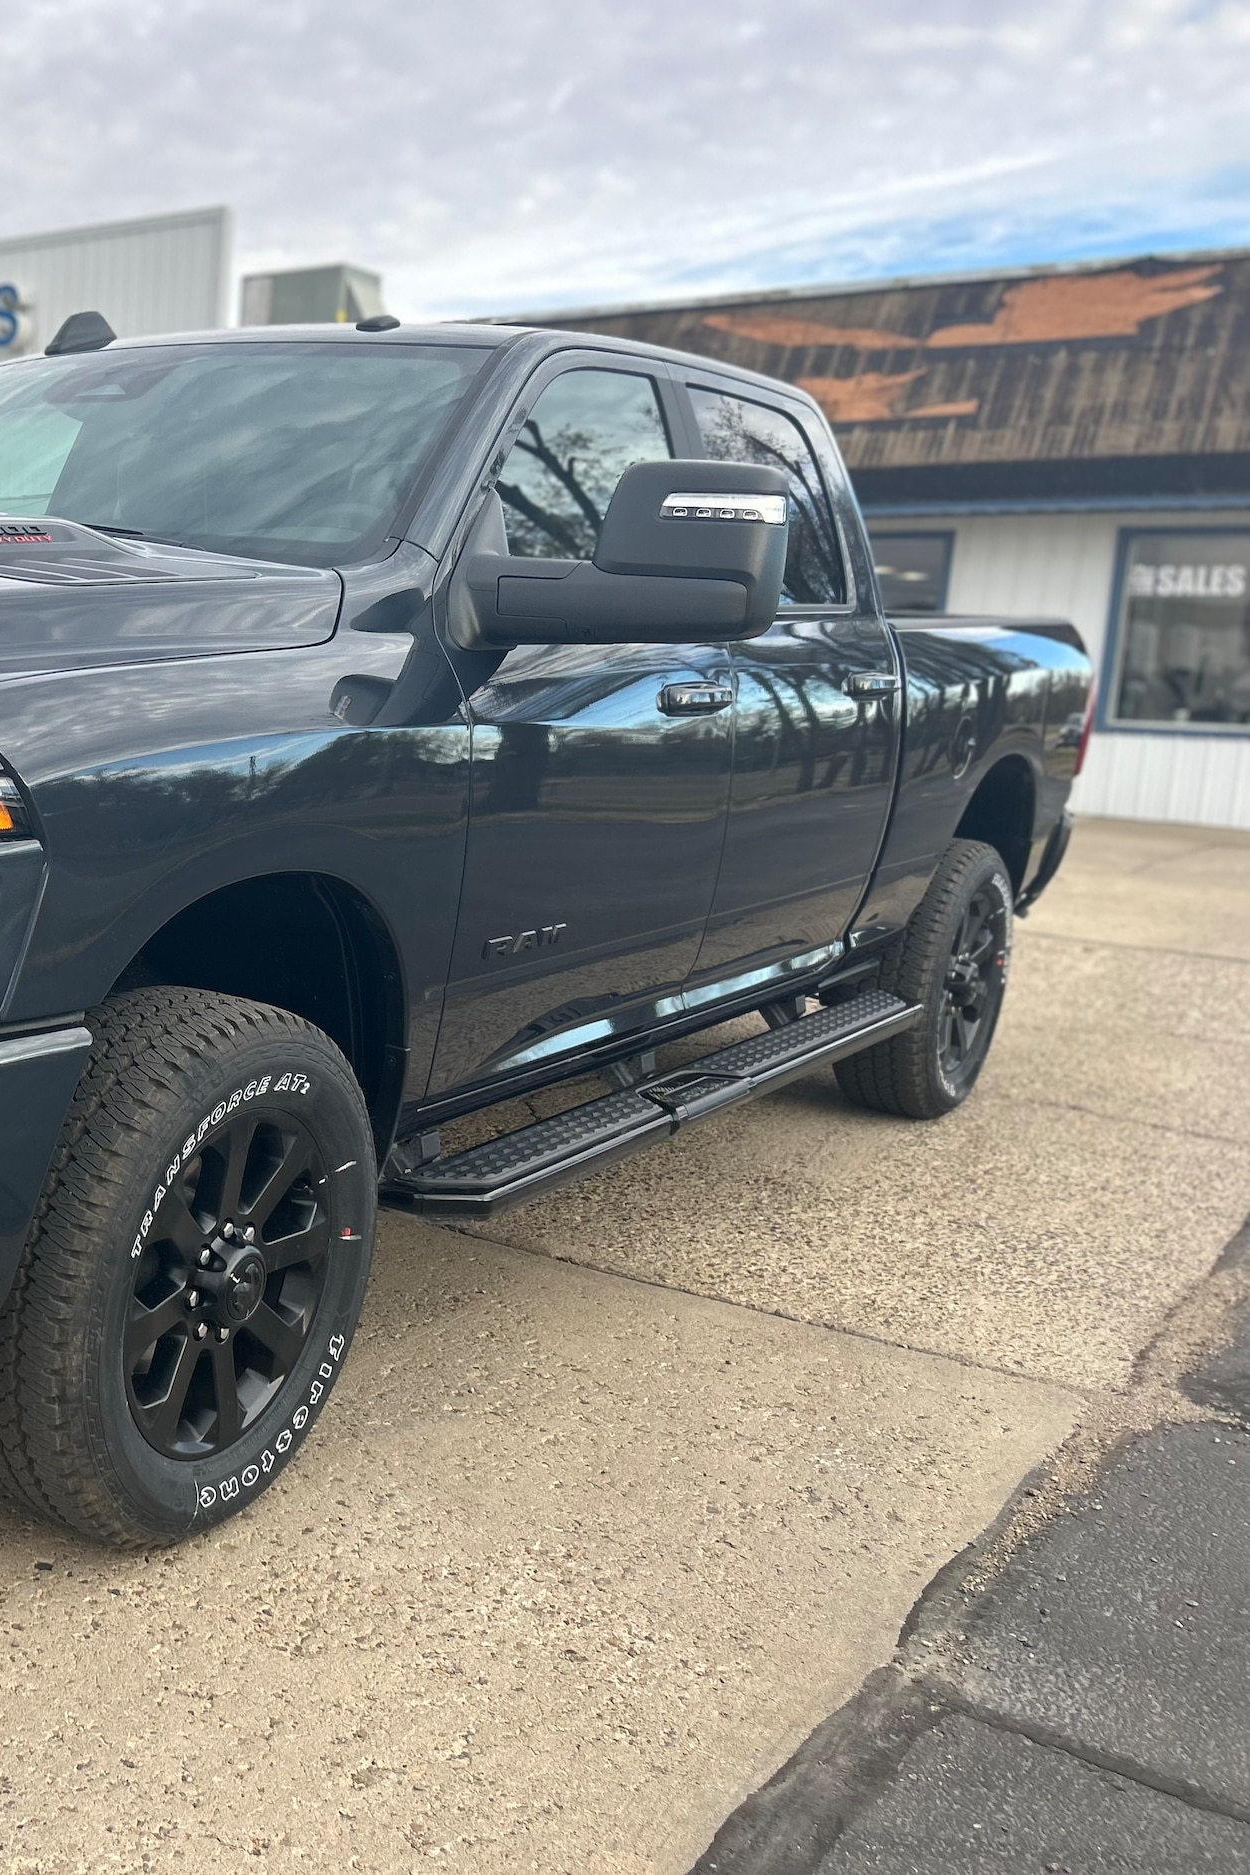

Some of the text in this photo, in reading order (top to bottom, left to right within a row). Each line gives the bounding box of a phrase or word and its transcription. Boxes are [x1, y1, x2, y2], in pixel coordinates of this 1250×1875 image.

[14, 534, 54, 544] DUTY
[1156, 563, 1248, 598] SALES
[131, 1076, 272, 1258] TRANSFORCE
